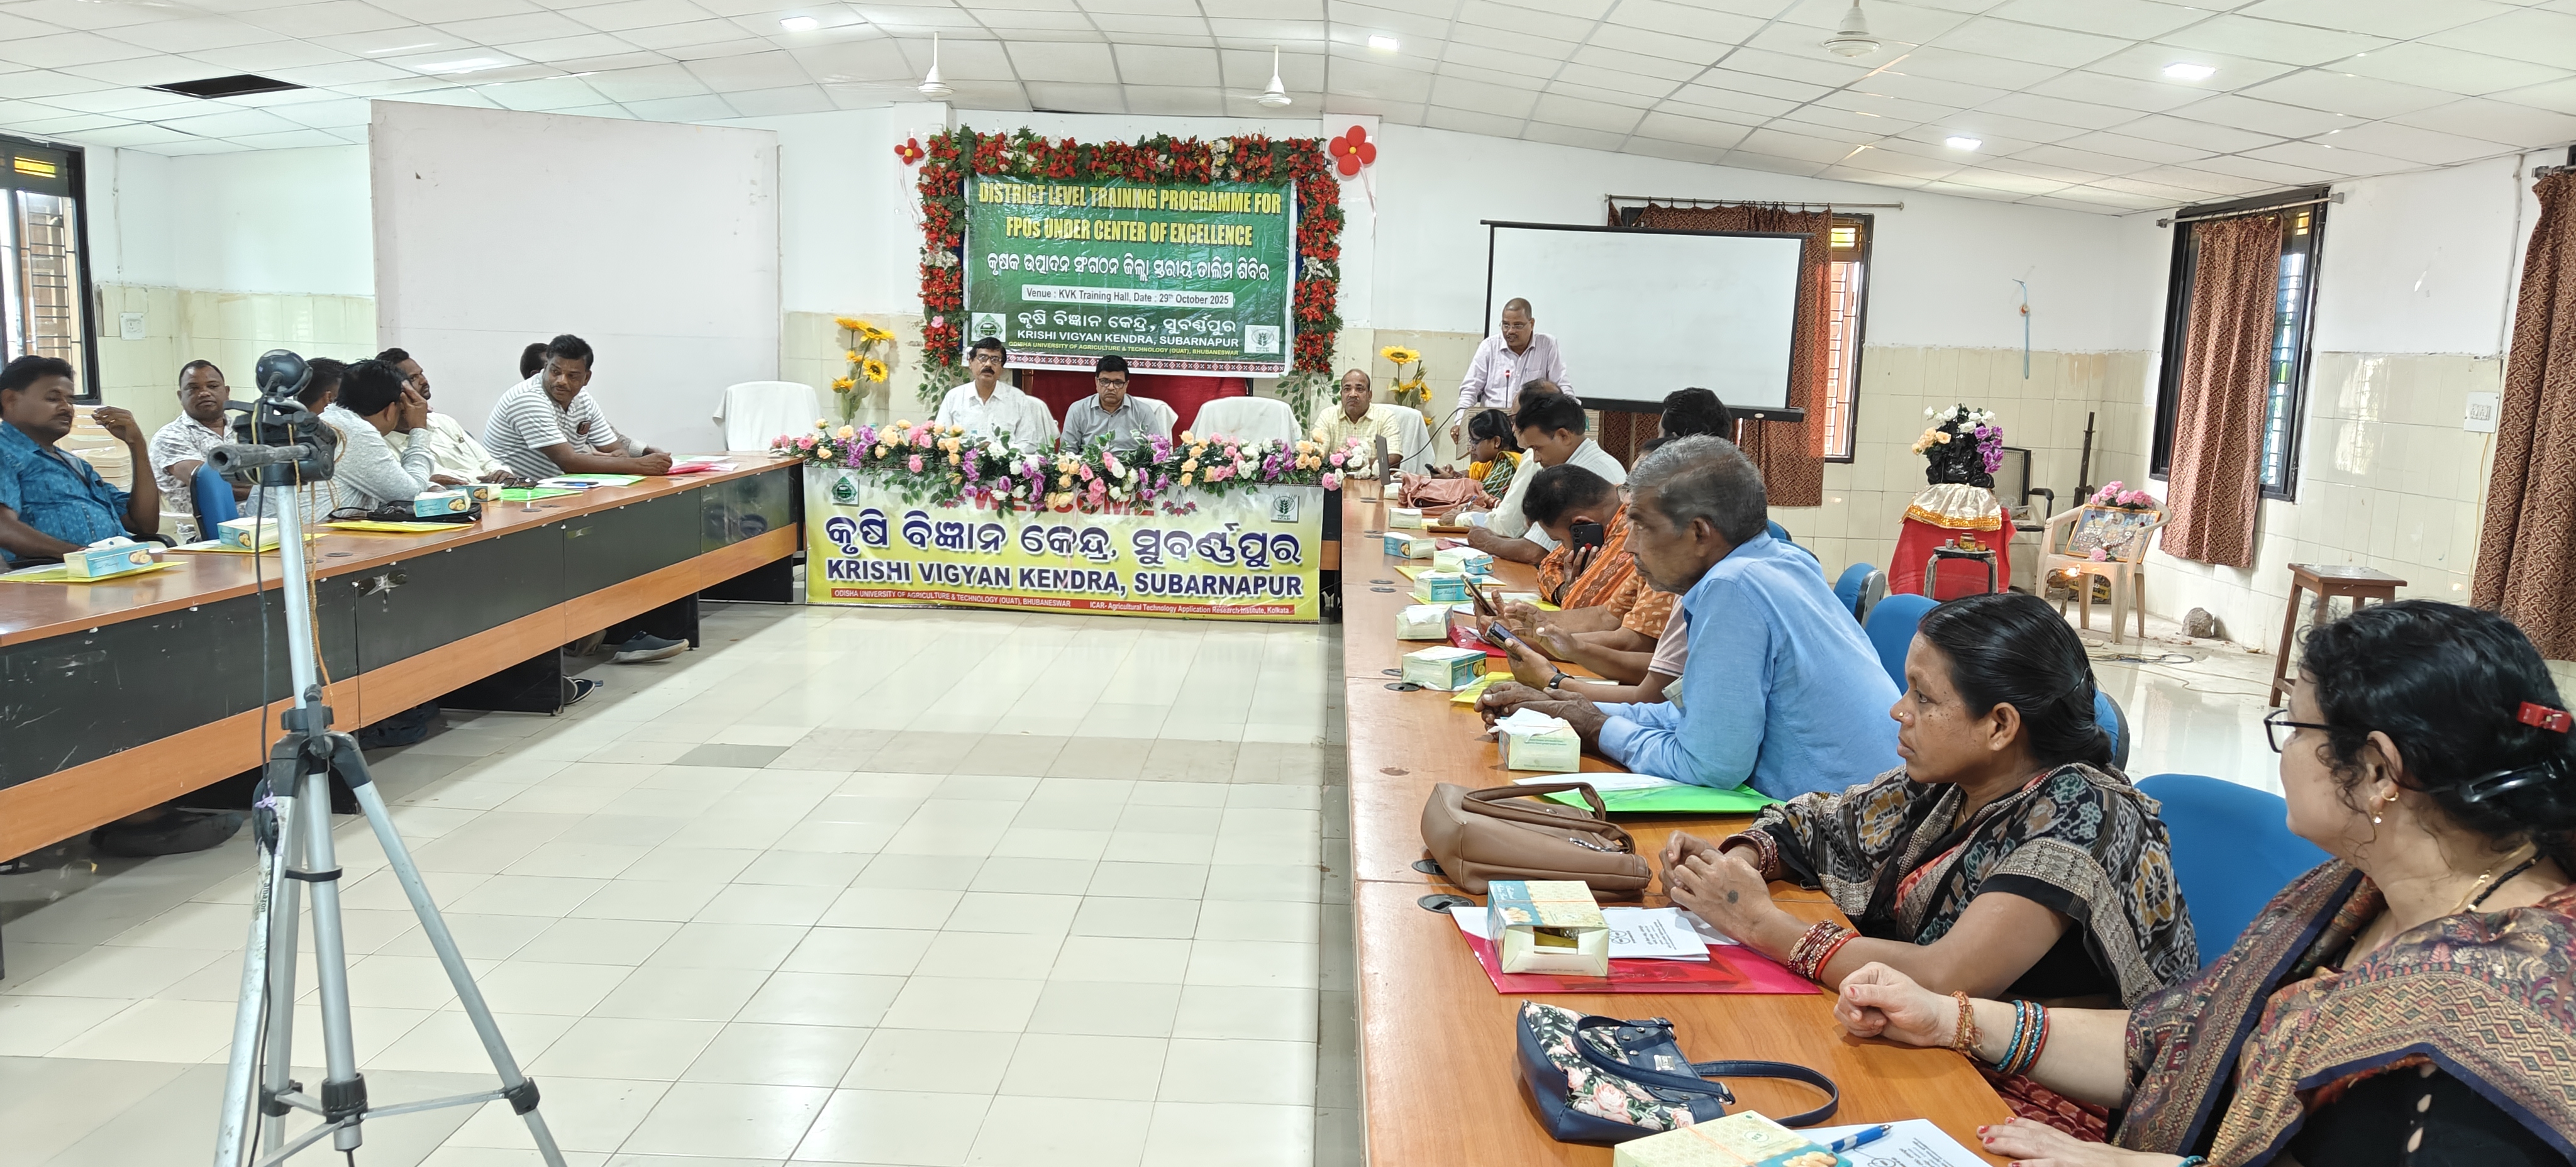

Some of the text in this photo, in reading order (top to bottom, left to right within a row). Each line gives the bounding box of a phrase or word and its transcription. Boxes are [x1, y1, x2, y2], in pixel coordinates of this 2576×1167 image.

[979, 182, 1281, 214] DISTRICT LEVEL TRAINING PROGRAMME FOR
[1006, 216, 1253, 246] FPOs UNDER CENTER OF EXCELLENCE
[987, 253, 1020, 275] କୃଷକ
[1024, 254, 1070, 274] ଉତ୍ପାଦନ
[1123, 252, 1149, 281] ଜିଲ୍ଲା
[1197, 256, 1233, 279] ତାଲିମ
[1237, 257, 1270, 281] ଶିବିର
[1026, 288, 1052, 297] Venue
[1058, 289, 1077, 299] KVK
[1079, 290, 1111, 302] Training
[1114, 292, 1131, 302] Hall,
[1134, 292, 1152, 302] Date
[1175, 294, 1208, 304] October
[1210, 295, 1229, 304] 2025
[1018, 309, 1046, 329] କୃଷି
[1053, 310, 1102, 328] ବିଜ୍ଞାନ
[1018, 330, 1239, 347] KRISHI VIGYAN KENDRA, SUBARNAPUR
[826, 508, 888, 555] କୃଷି
[902, 510, 1006, 551] ବିଜ୍ଞାନ
[828, 559, 1302, 596] KRISHI VIGYAN KENDRA, SUBARNAPUR
[859, 590, 896, 598] UNIVERSITY
[907, 592, 950, 600] AGRICULTURE
[957, 594, 999, 604] TECHNOLOGY
[999, 595, 1022, 606] (OUAT),
[1023, 598, 1070, 607] BHUBANESWAR
[1108, 602, 1141, 611] Agricultural
[1143, 604, 1177, 613] Technology
[1177, 605, 1211, 614] Application
